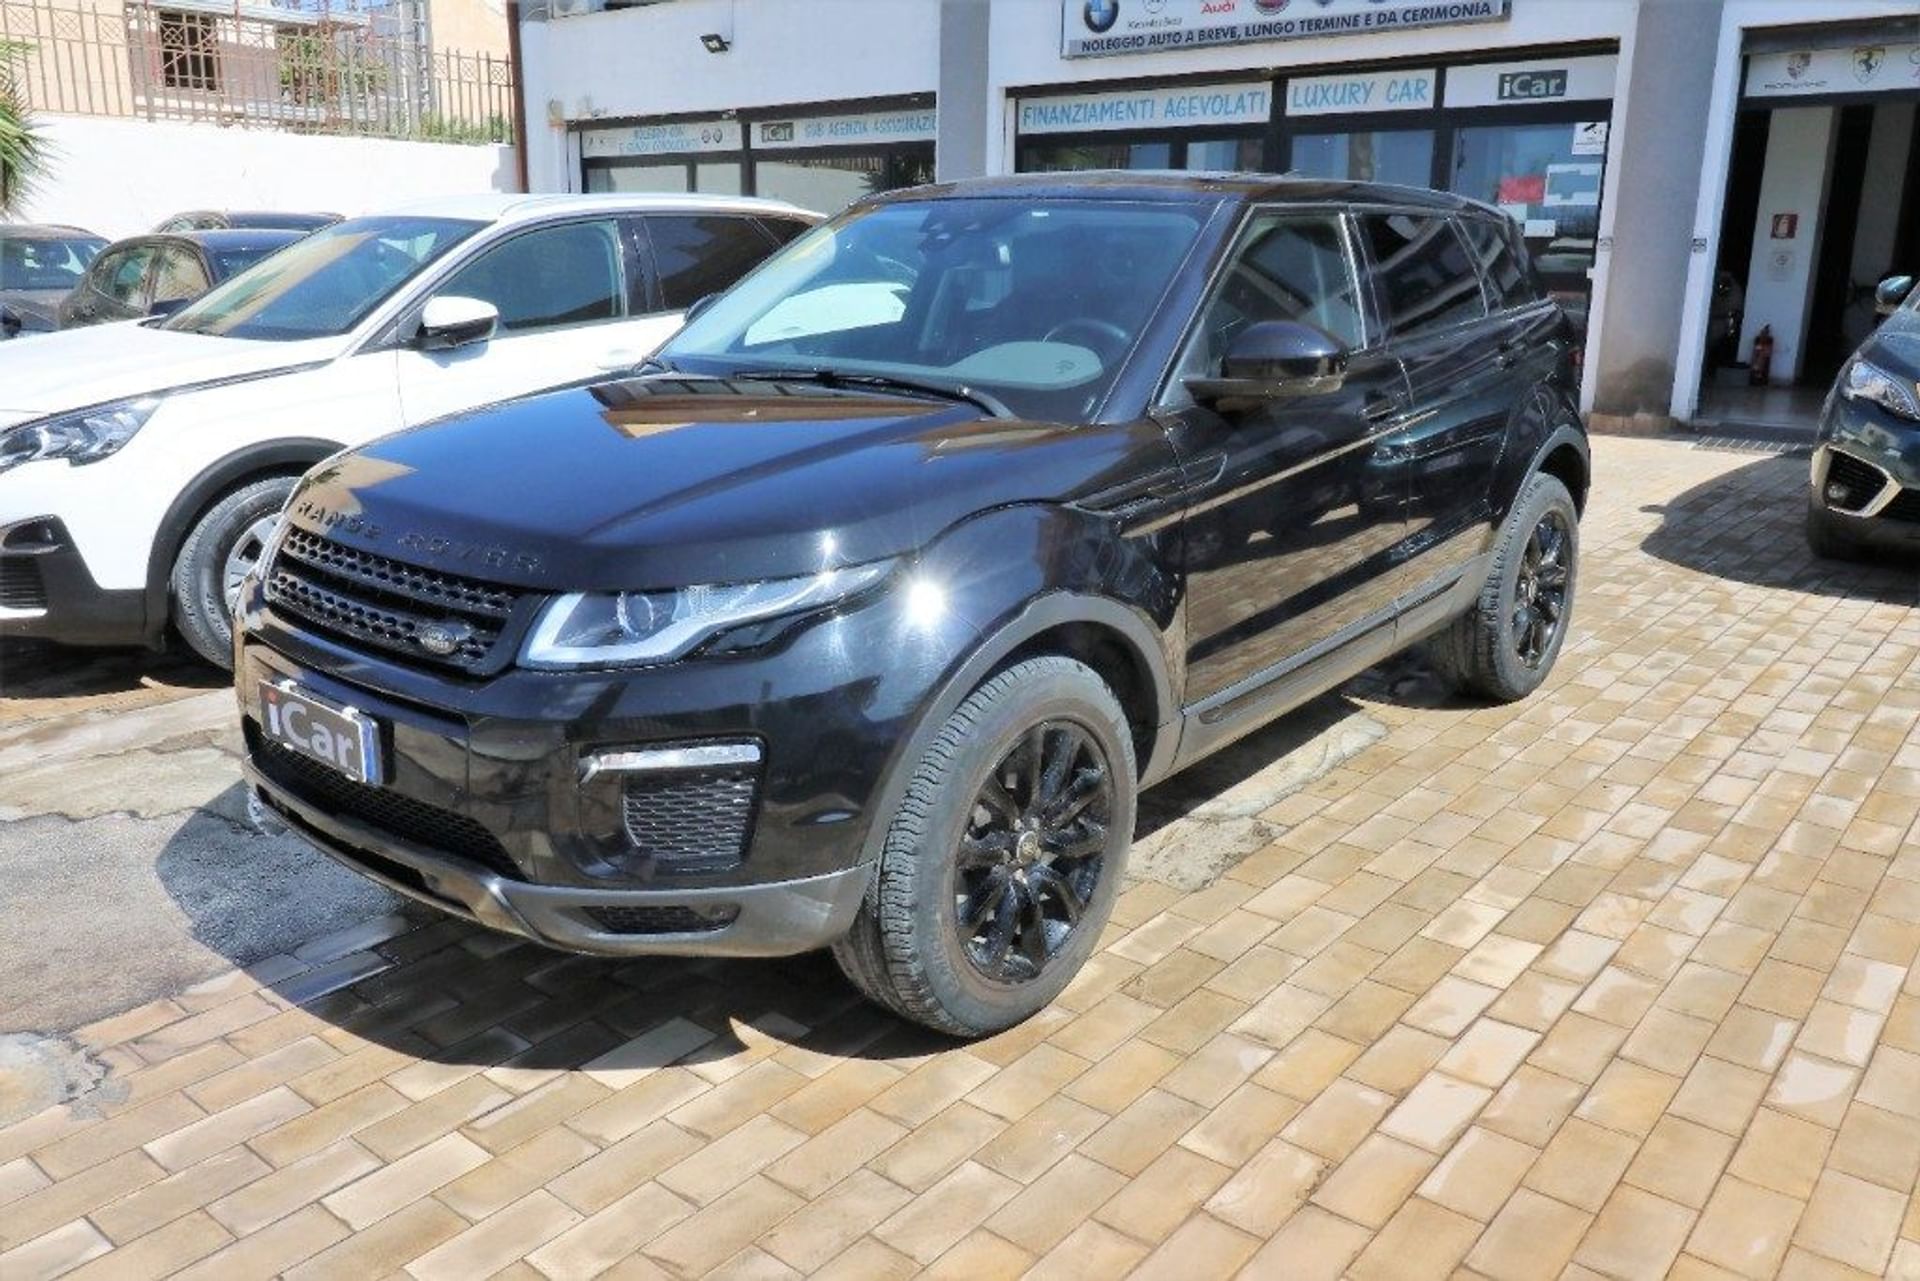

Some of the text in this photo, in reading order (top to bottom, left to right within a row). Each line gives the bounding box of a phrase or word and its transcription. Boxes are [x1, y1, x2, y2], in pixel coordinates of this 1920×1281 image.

[1201, 1, 1236, 14] Audi
[1081, 2, 1492, 52] NOLEGGIO AUTO A BREVE, LUNGO TERMINE E DA CERIMONIA
[1292, 78, 1428, 108] LUXURY CAR
[1502, 74, 1562, 97] iCar
[1022, 91, 1266, 127] FINANZIAMENTI AGEVOLATI
[266, 690, 353, 769] iCar
